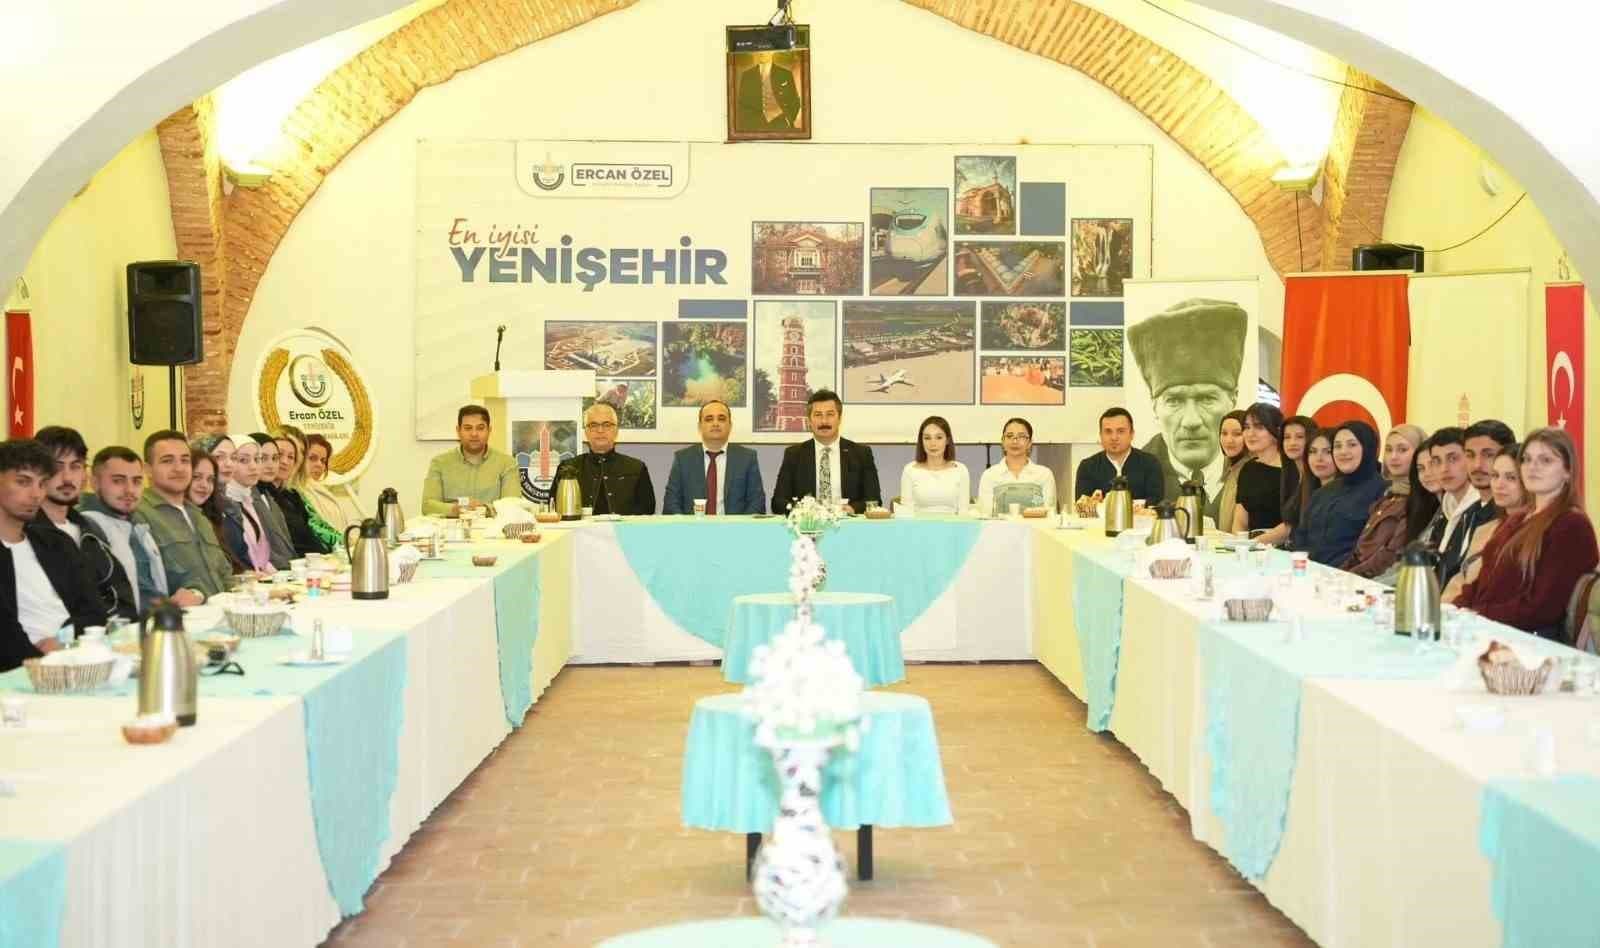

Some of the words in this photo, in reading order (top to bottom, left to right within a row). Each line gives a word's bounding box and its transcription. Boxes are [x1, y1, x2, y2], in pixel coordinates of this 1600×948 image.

[576, 168, 626, 180] ERCAN
[631, 166, 669, 181] ÖZEL
[448, 217, 480, 246] En
[488, 224, 540, 258] iyisi
[449, 234, 728, 292] YENİŞEHİR
[289, 410, 316, 420] Ercan
[318, 408, 344, 420] ÖZEL
